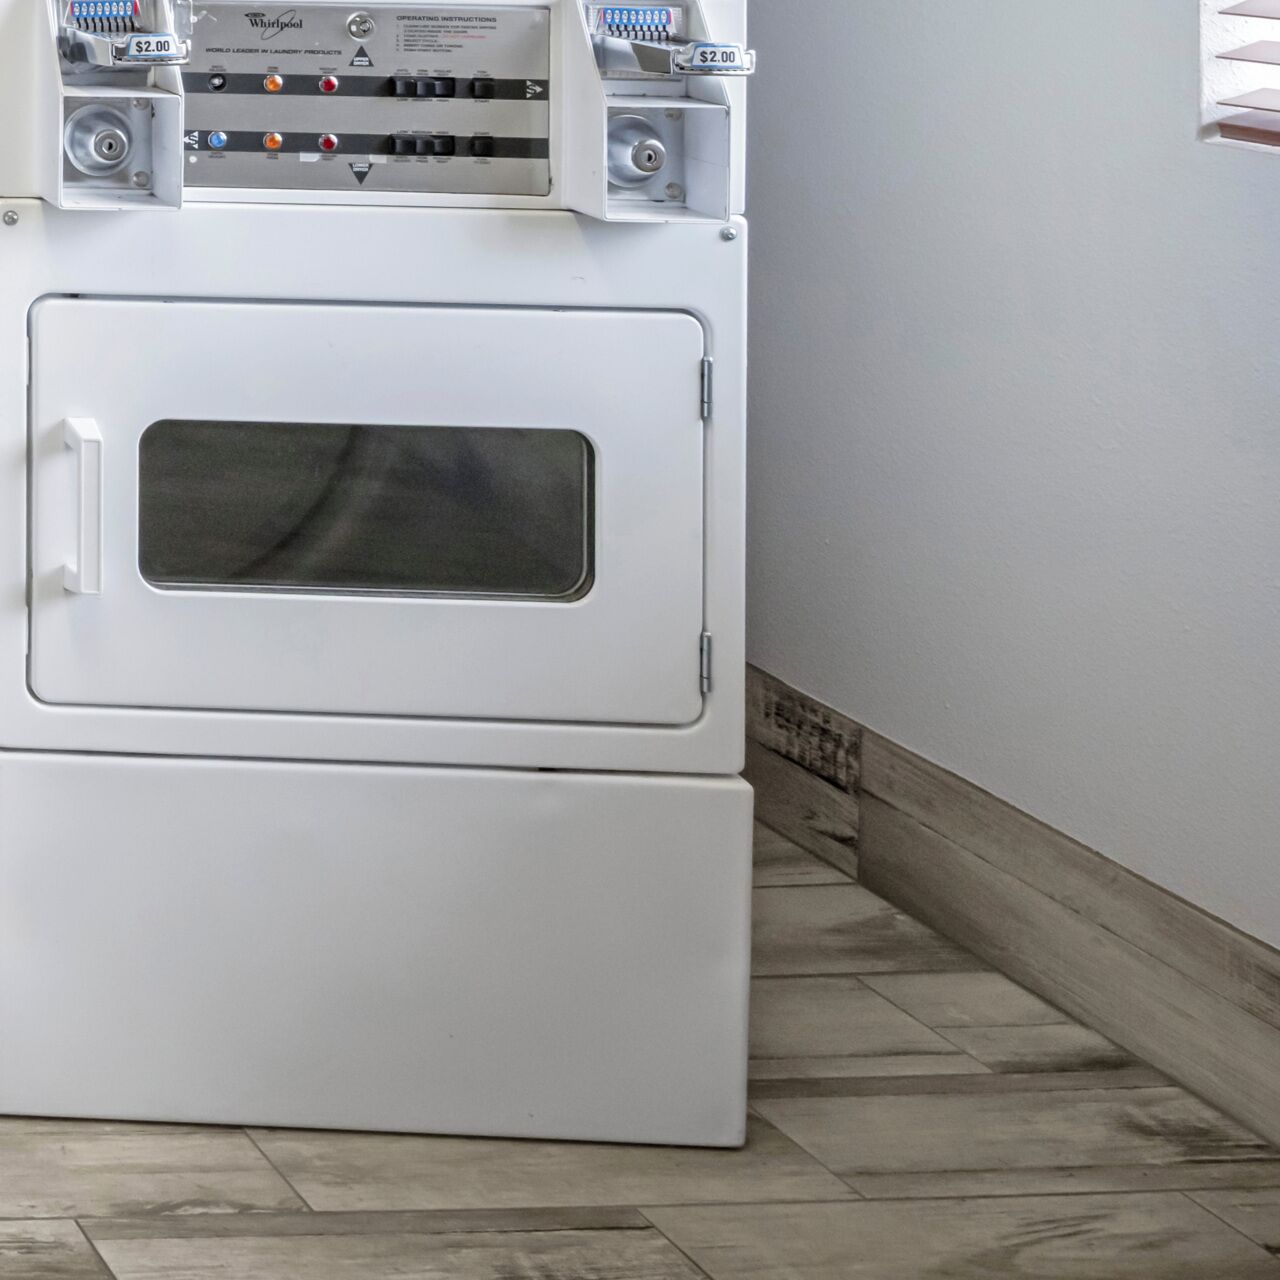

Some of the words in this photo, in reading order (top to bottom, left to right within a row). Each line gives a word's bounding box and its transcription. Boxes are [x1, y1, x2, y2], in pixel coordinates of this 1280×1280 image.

[249, 19, 303, 31] Whirlpool
[136, 40, 169, 53] $2.00
[700, 51, 735, 63] $2.00
